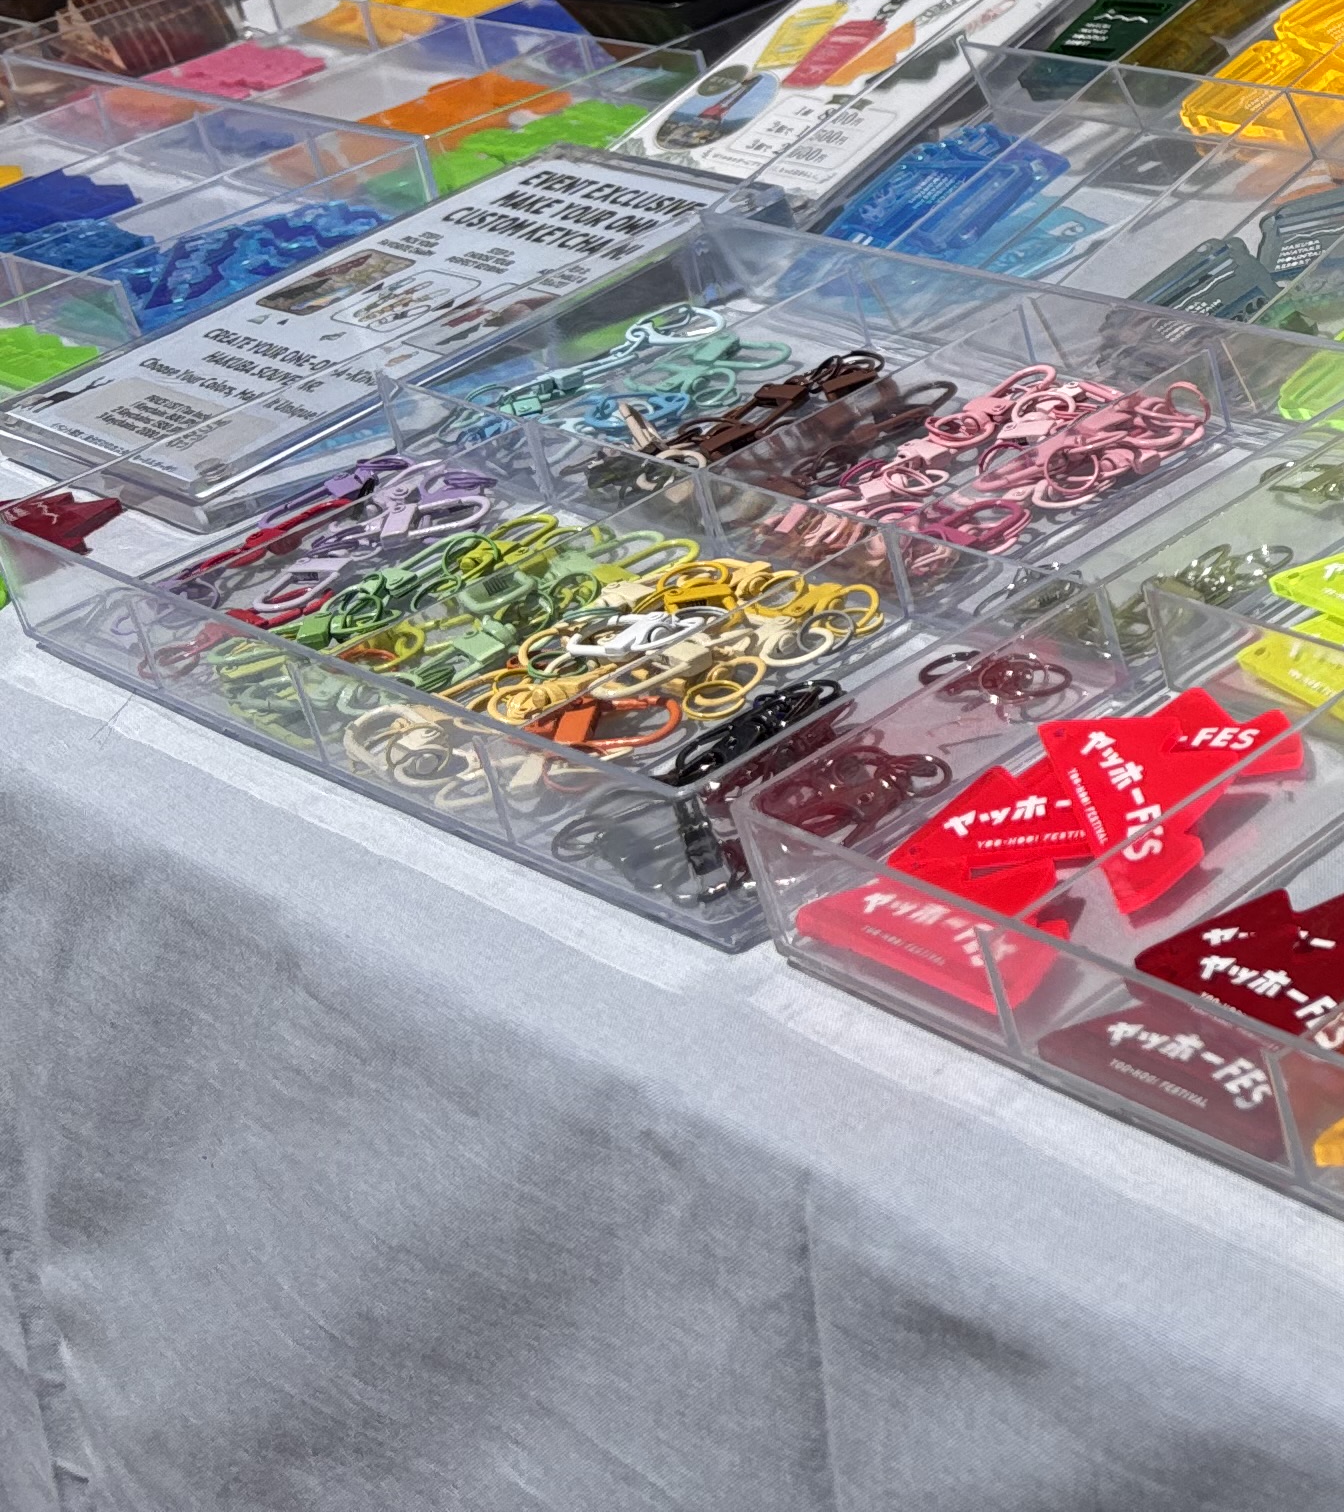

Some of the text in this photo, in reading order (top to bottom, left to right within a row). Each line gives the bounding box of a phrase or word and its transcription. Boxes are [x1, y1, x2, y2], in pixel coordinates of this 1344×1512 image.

[519, 170, 592, 200] EVENT
[442, 206, 531, 241] CUSTOM
[491, 190, 564, 216] MAKE
[550, 201, 617, 227] YOUR
[203, 328, 254, 350] CREATE
[249, 337, 289, 361] YOUR
[139, 357, 183, 377] Choose
[176, 367, 205, 386] Your
[202, 351, 254, 374] HAKUBA
[1080, 729, 1164, 862] ヤッホーFES
[1106, 1021, 1273, 1110] ヤッホーFES
[1157, 1080, 1209, 1109] FESTIVAL
